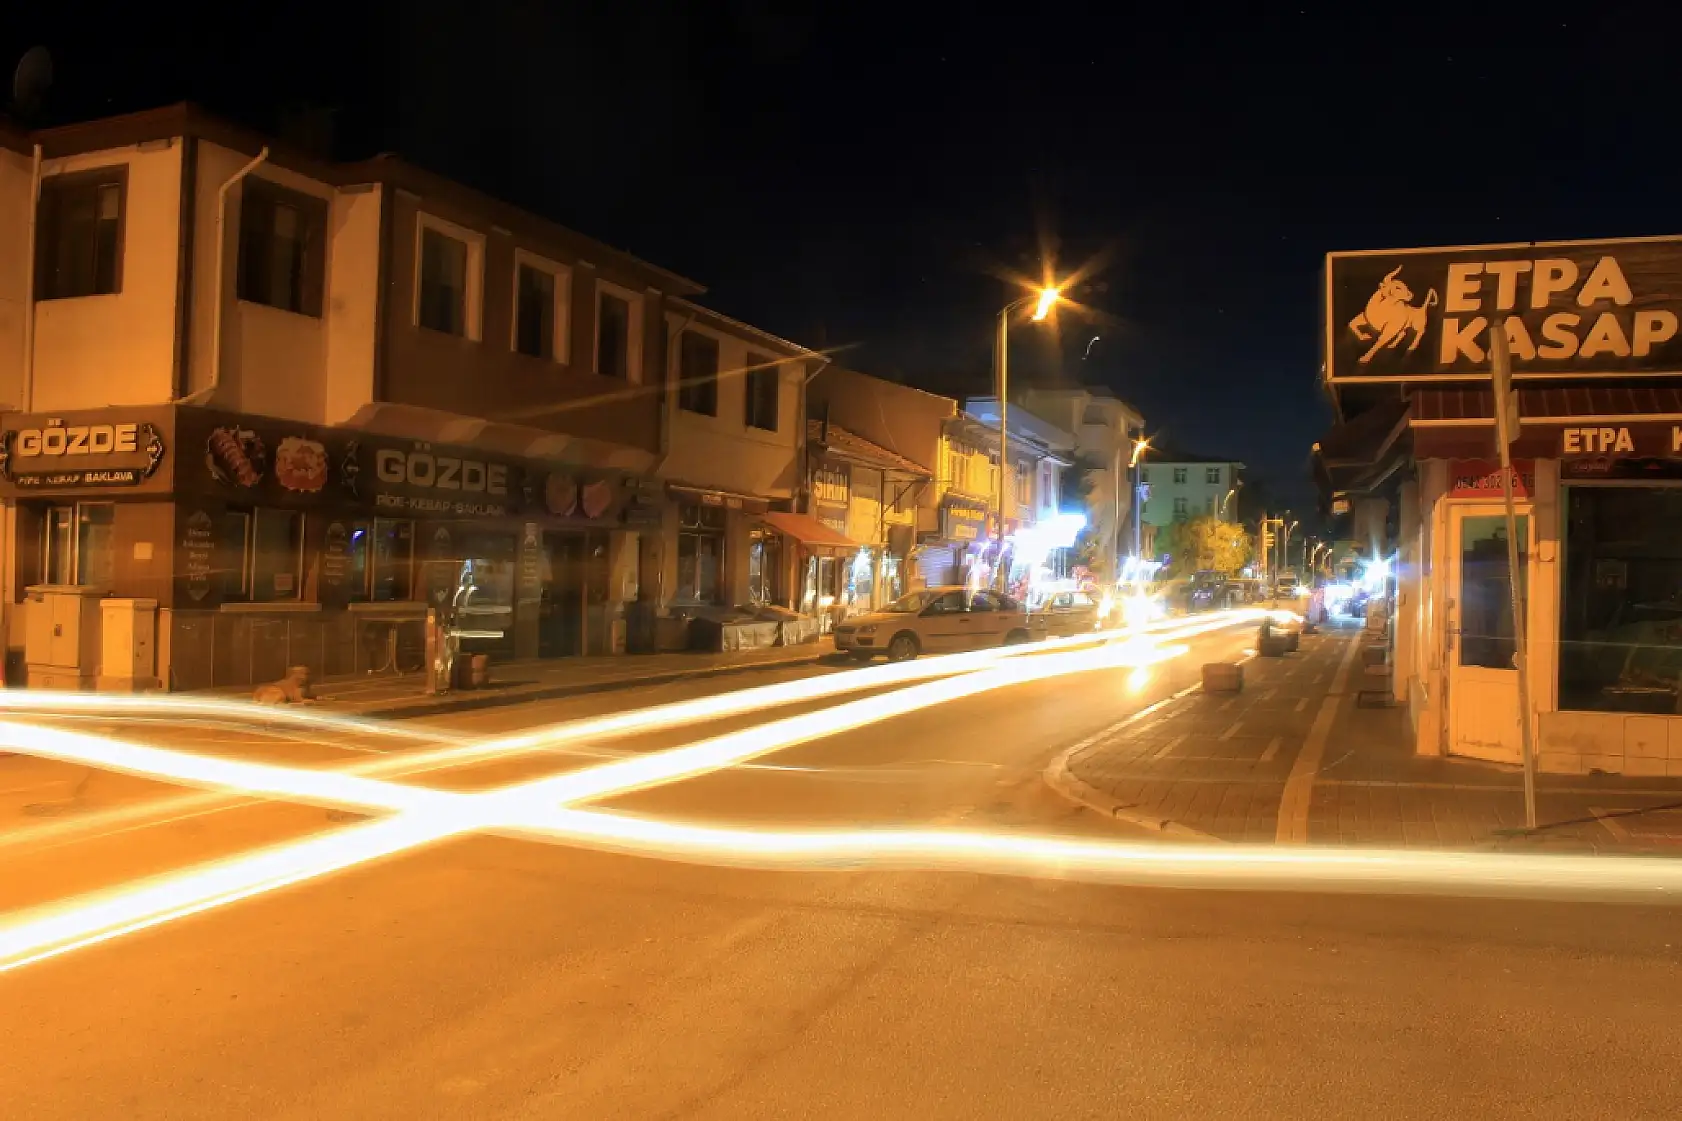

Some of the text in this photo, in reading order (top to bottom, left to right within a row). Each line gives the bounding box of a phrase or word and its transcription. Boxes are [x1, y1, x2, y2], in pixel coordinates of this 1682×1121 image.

[1446, 256, 1634, 313] ETPA
[1440, 310, 1679, 364] KASAP
[17, 418, 137, 457] GÖZDE
[1563, 427, 1635, 454] ETPA
[84, 471, 134, 483] BAKLAVA
[375, 442, 508, 496] GÖZDE
